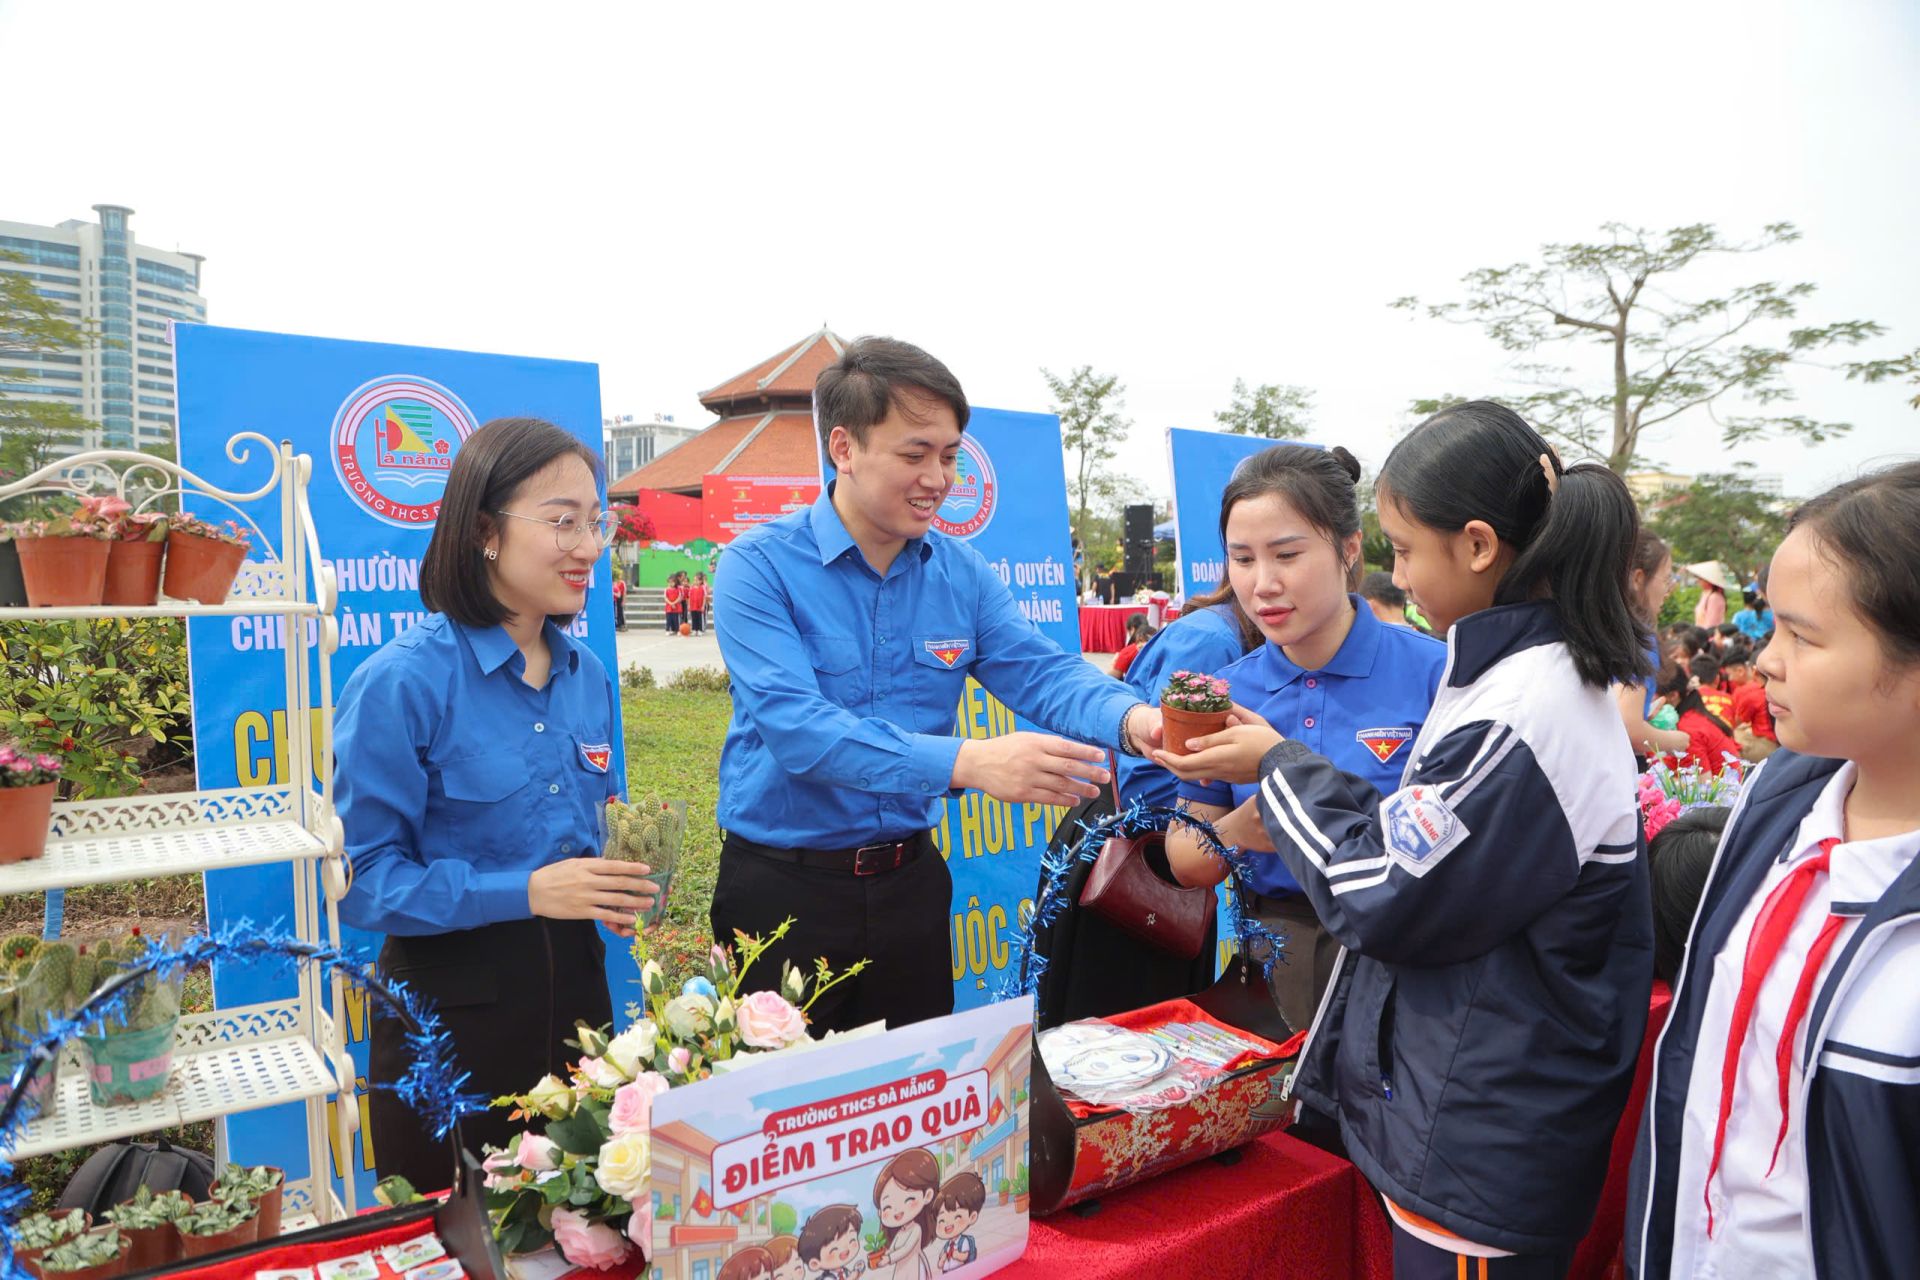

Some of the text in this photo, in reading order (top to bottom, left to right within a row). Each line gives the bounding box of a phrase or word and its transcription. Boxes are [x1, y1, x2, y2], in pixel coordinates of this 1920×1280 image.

[389, 505, 430, 521] THCS
[942, 523, 967, 535] THCS
[318, 550, 424, 592] HƯỜN
[776, 1076, 936, 1133] TRƯỜNG THCS ĐÀ NẴNG
[722, 1085, 982, 1194] ĐIỂM TRAO QUÀ
